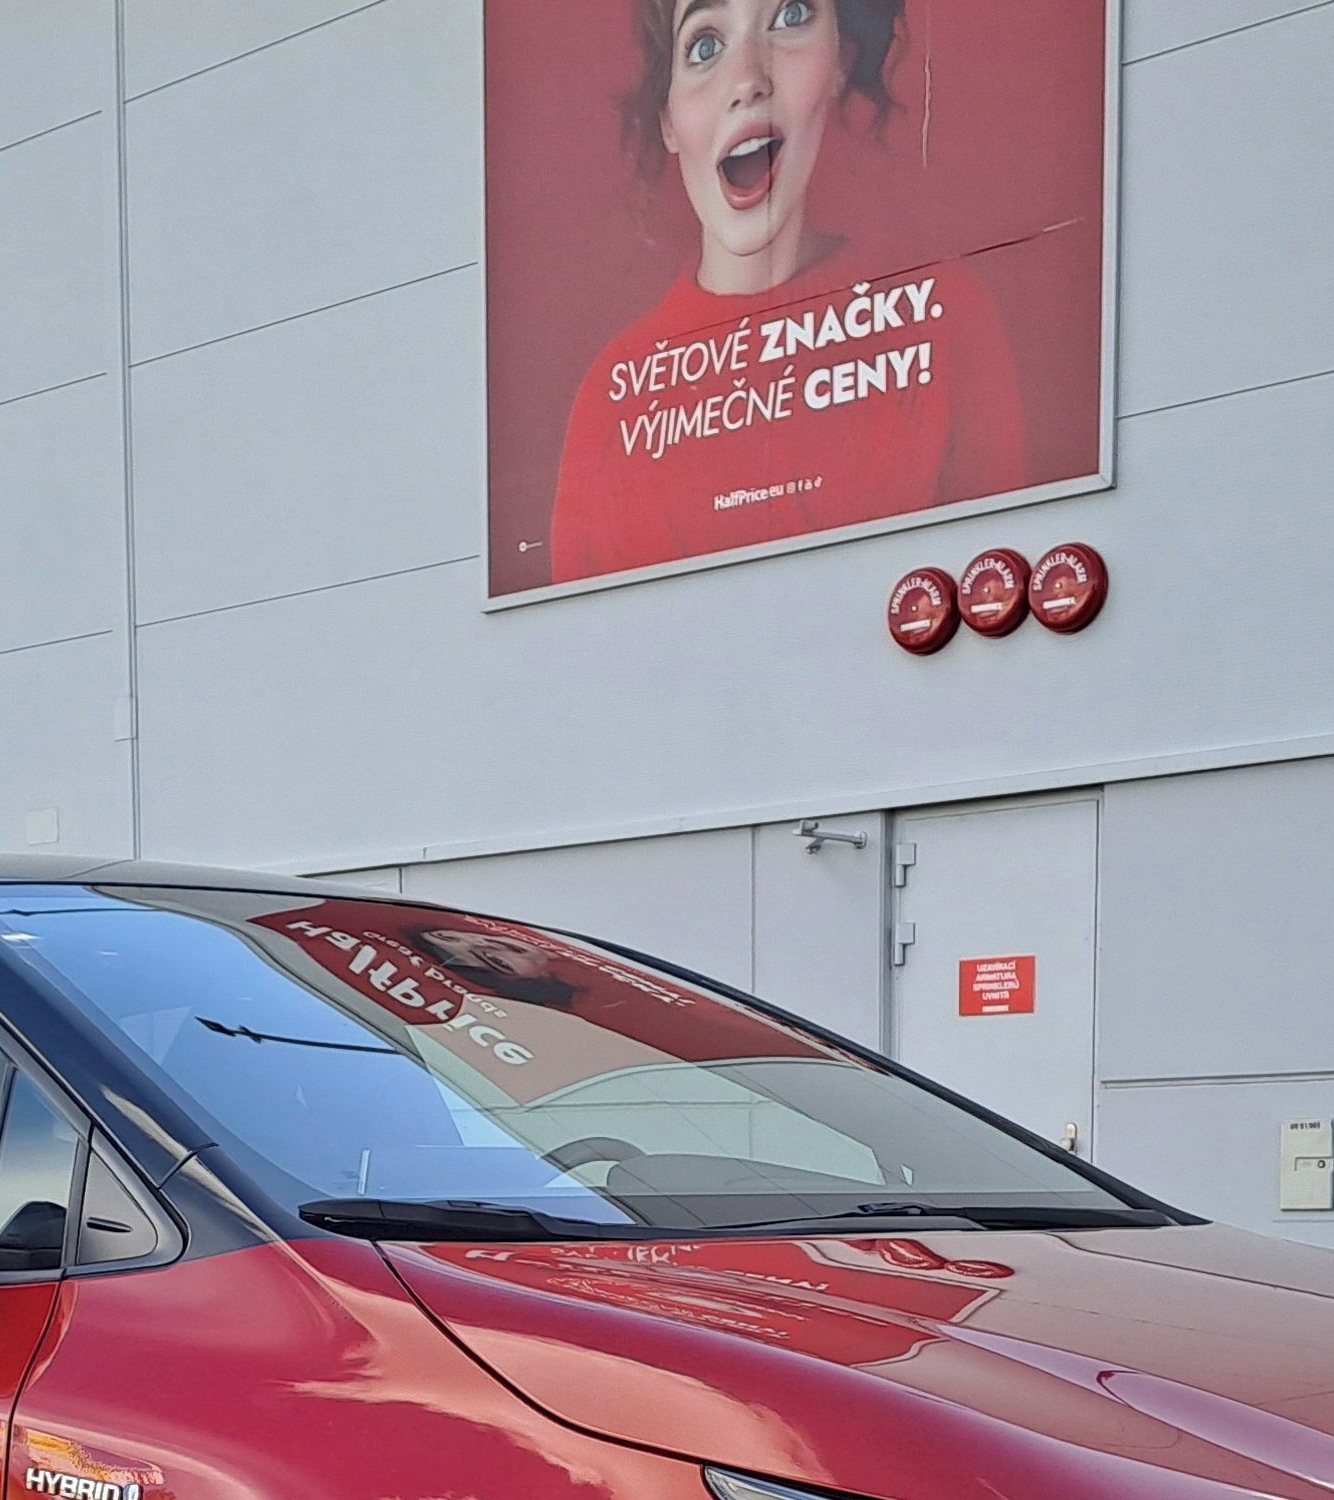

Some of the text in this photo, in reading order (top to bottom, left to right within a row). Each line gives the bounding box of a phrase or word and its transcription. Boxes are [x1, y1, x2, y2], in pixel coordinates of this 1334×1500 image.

[608, 278, 944, 402] SVĚTOVÉ ZNAČKY.
[619, 341, 933, 459] VÝJIMEČNÉ CENY!
